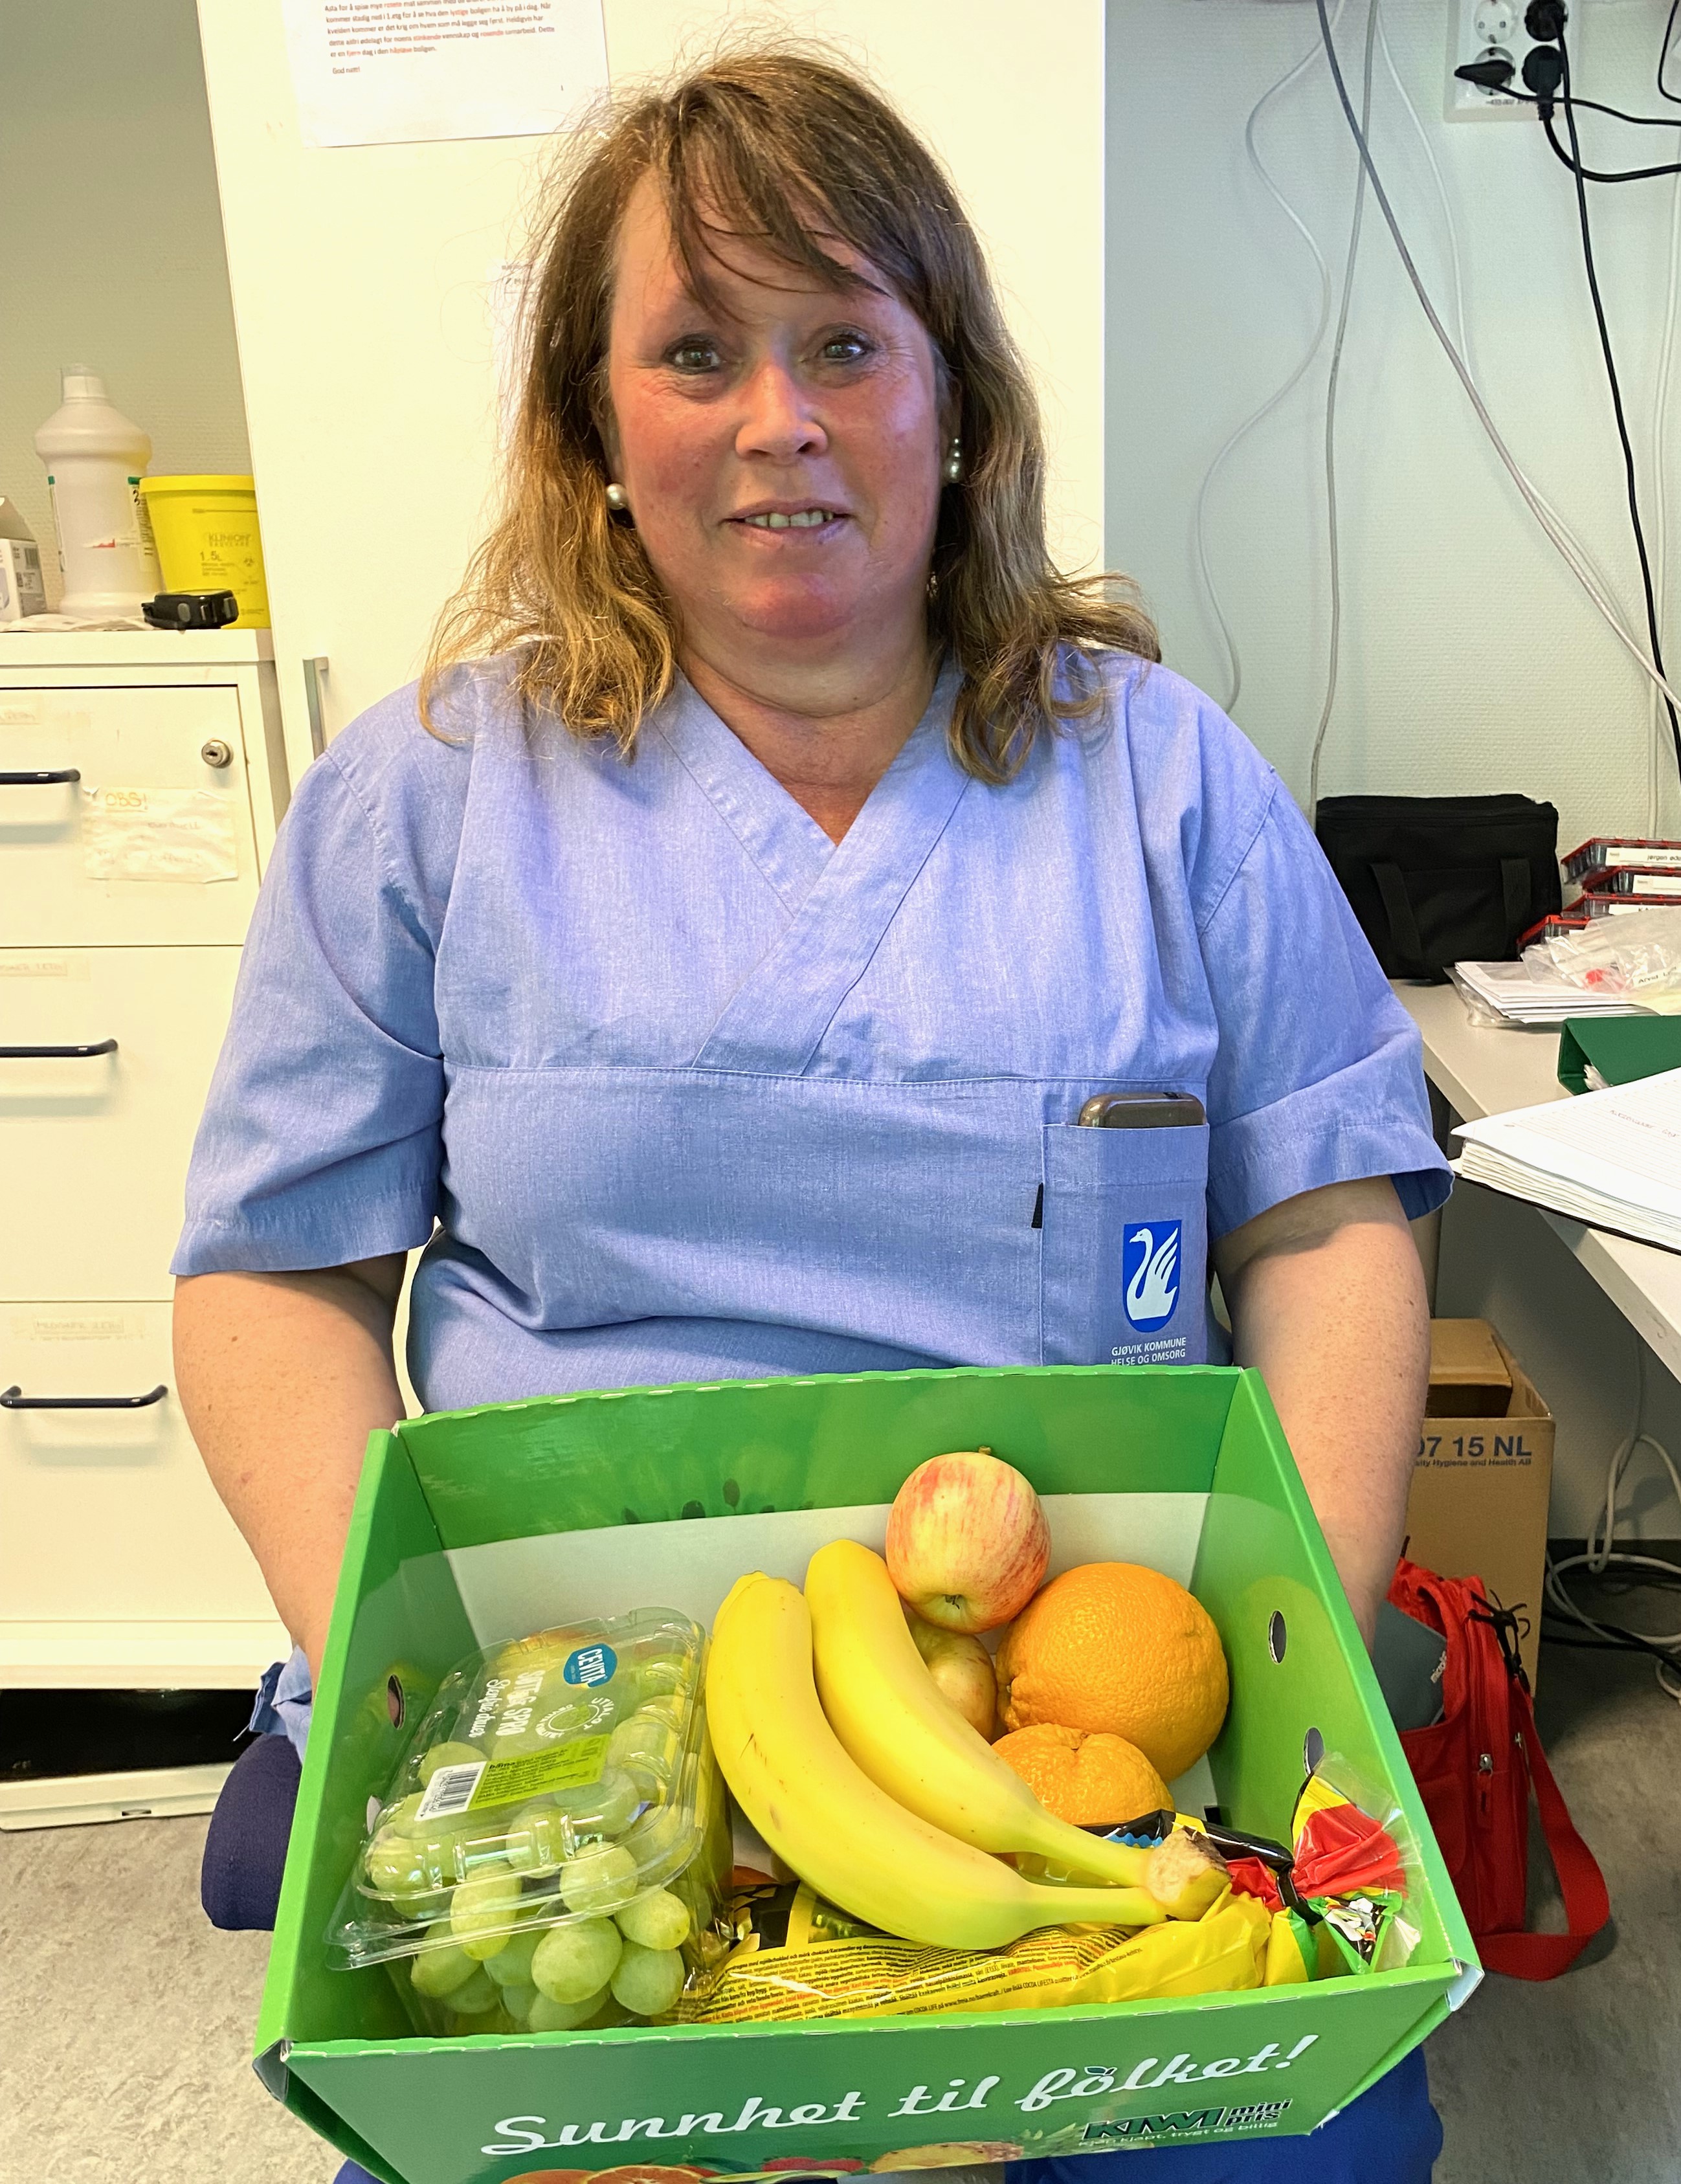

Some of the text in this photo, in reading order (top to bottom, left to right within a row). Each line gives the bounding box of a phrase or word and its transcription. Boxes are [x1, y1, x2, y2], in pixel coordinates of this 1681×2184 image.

[105, 792, 148, 810] OBS!
[1111, 1337, 1186, 1356] GJØVIK KOMMUNE
[1111, 1348, 1186, 1366] HELSE OG OMSORG
[1453, 1436, 1484, 1457] 15
[1494, 1435, 1532, 1456] NL
[1432, 1459, 1467, 1467] Hygiene
[1489, 1458, 1516, 1466] Health
[577, 1648, 606, 1683] CEVITA
[469, 1713, 497, 1738] druer
[495, 1707, 533, 1737] SPRØ
[1023, 1981, 1037, 1989] COCOA
[481, 2034, 1319, 2156] Sunnhet til folket!
[1082, 2097, 1293, 2141] KIWI mini
[1225, 2110, 1281, 2126] pris
[1171, 2129, 1210, 2138] trygt
[1238, 2121, 1278, 2132] billig
